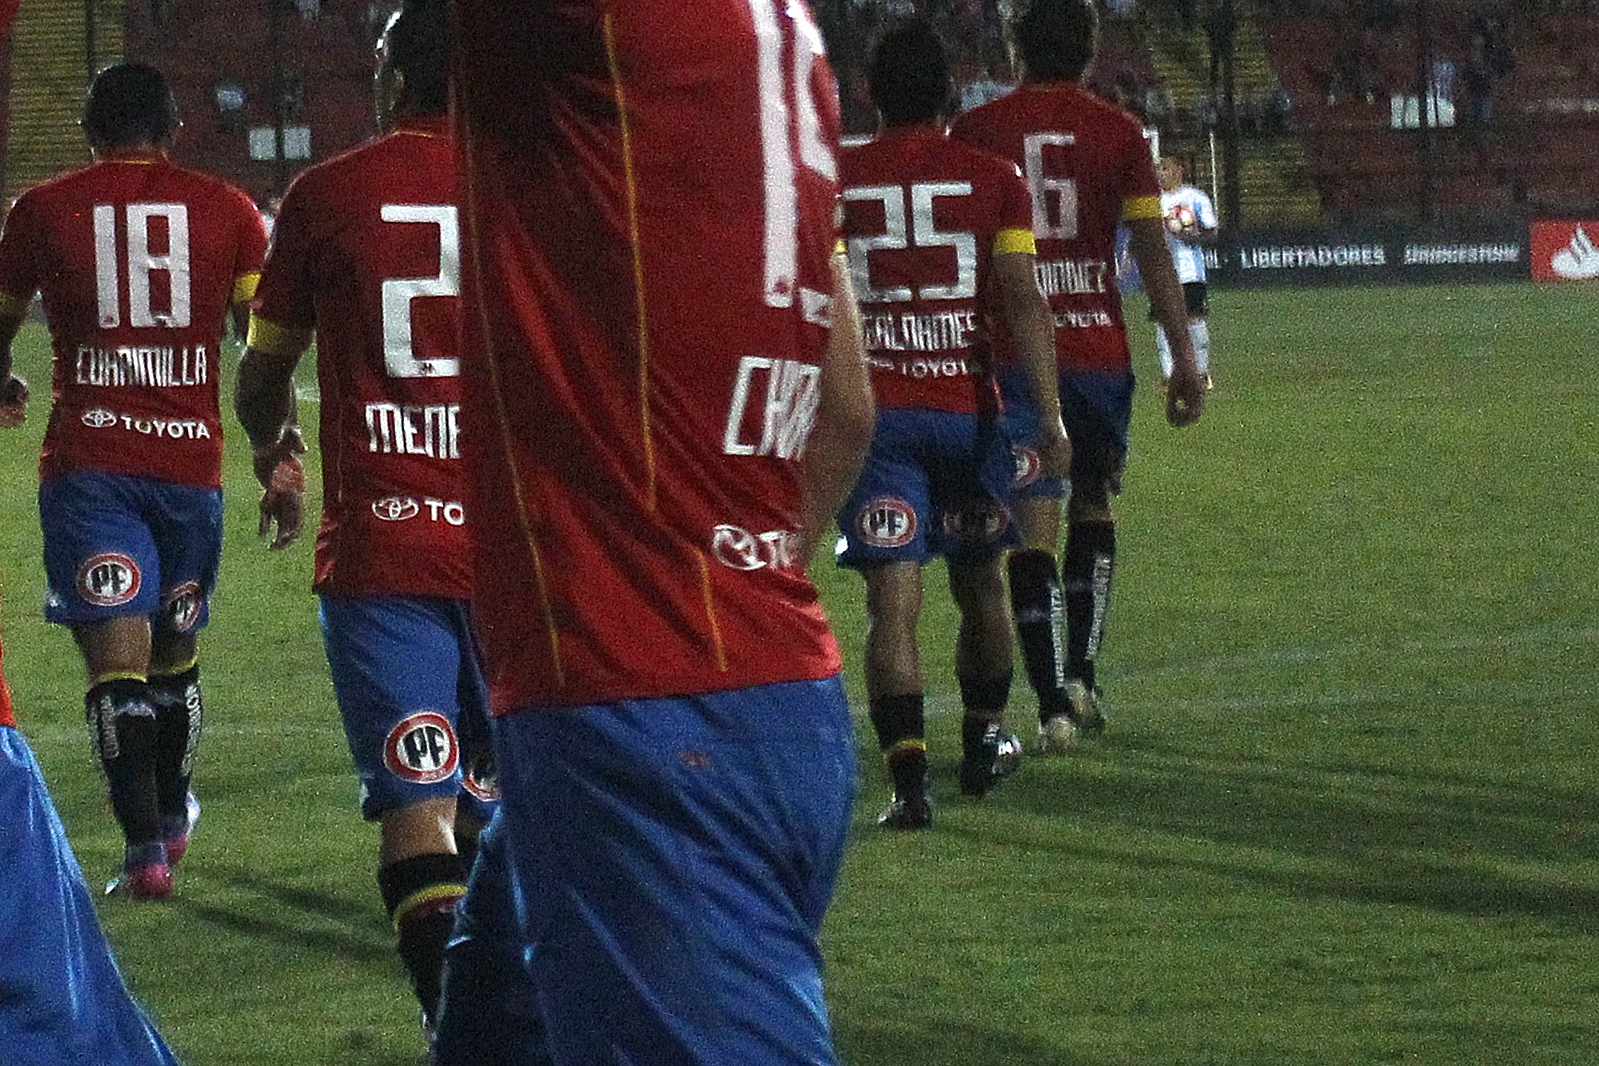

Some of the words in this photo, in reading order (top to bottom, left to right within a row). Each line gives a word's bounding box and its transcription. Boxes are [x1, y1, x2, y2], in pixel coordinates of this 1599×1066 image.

[841, 181, 977, 304] 25
[1024, 133, 1078, 239] 6
[93, 203, 191, 328] 18
[120, 415, 210, 439] TOYOTA
